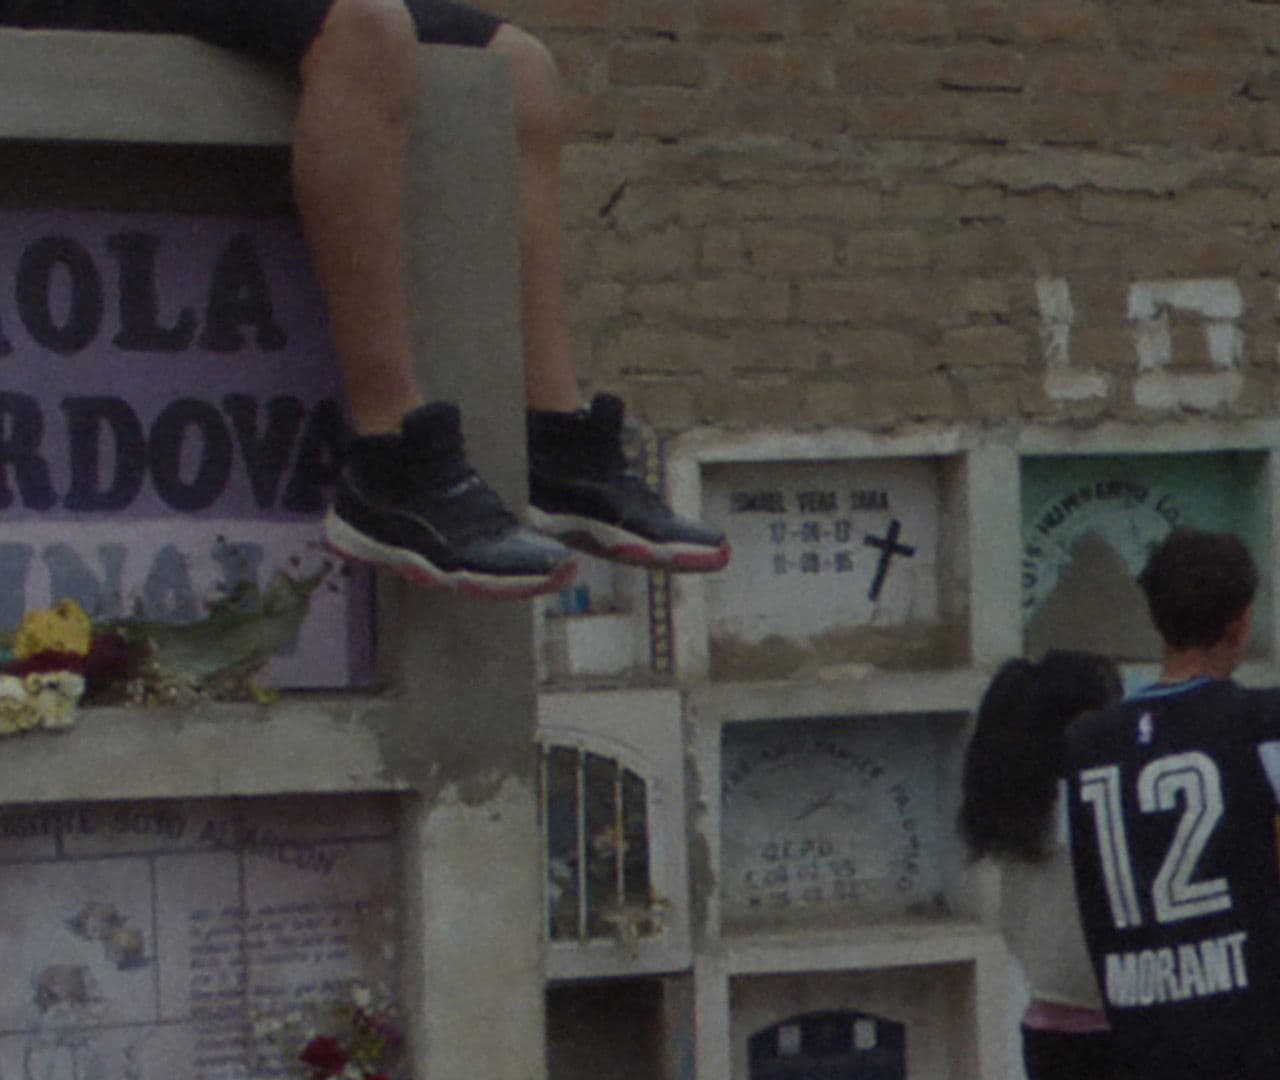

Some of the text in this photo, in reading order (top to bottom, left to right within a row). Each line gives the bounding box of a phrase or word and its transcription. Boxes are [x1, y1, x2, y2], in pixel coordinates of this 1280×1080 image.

[0, 230, 288, 354] OLA
[1080, 751, 1232, 927] 12
[1105, 931, 1249, 1009] MORANT
